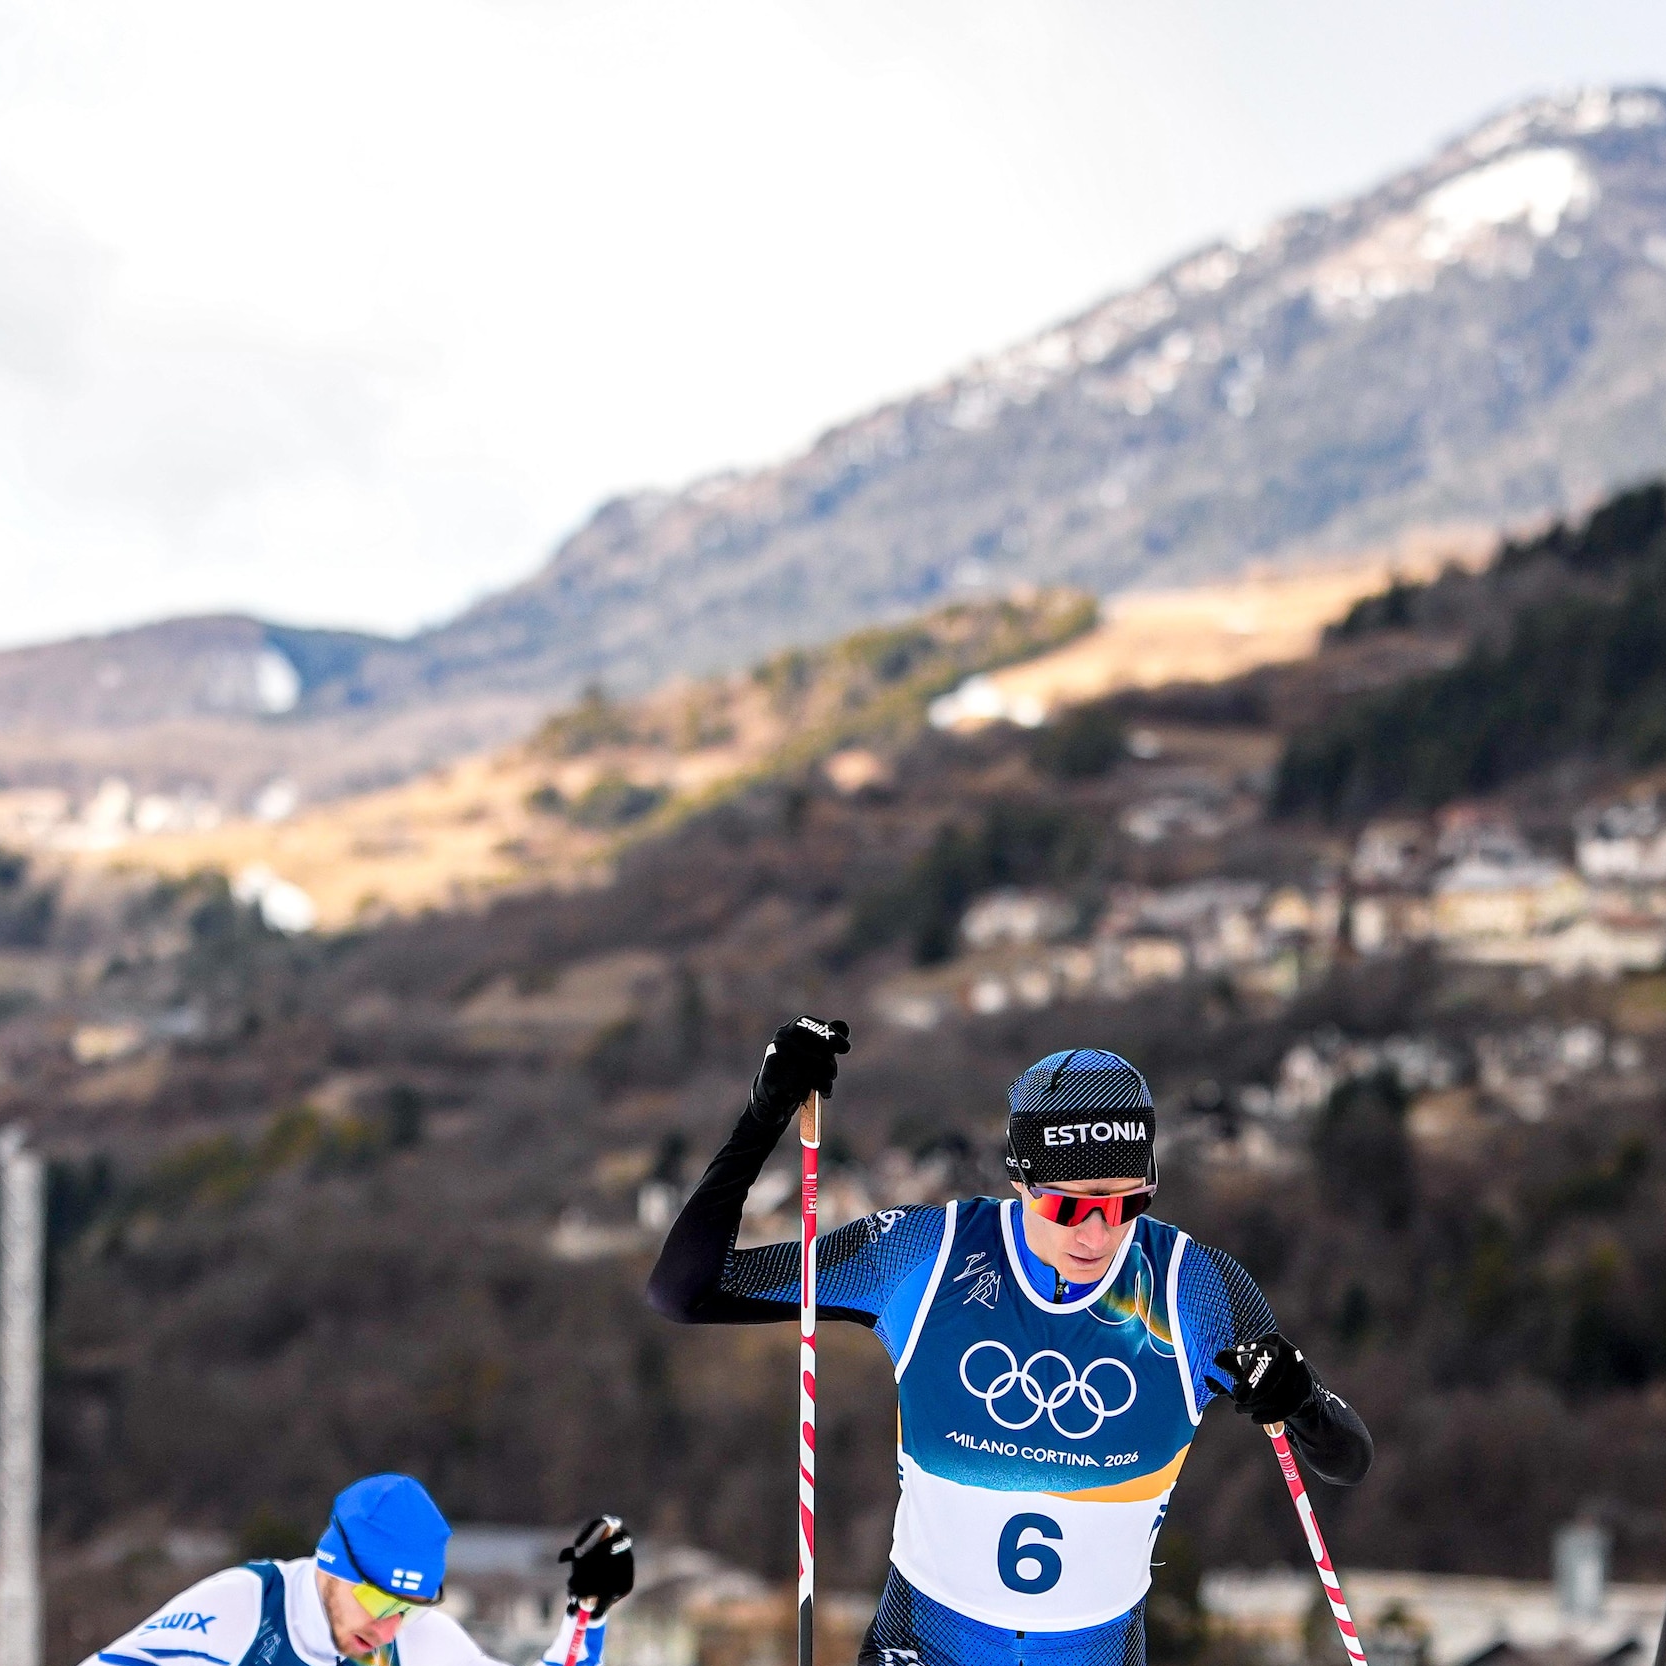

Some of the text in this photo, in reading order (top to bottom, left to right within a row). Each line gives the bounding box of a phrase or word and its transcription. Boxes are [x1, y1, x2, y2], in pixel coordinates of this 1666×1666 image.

[1044, 1121, 1147, 1146] ESTONIA
[945, 1430, 1140, 1467] MILANO CORTINA 2026
[997, 1512, 1064, 1595] 6
